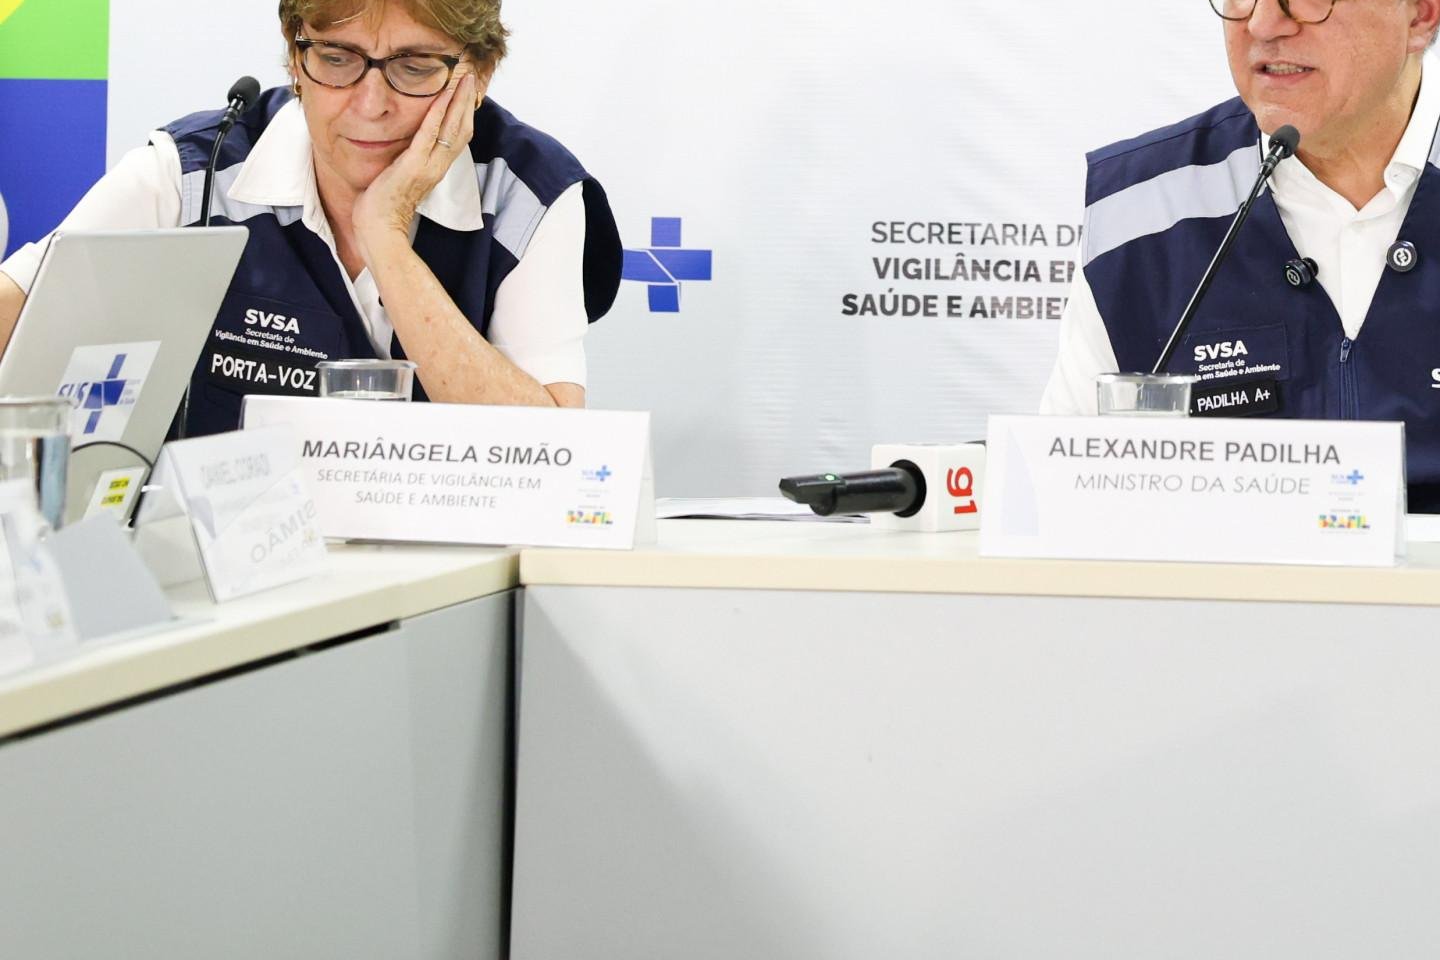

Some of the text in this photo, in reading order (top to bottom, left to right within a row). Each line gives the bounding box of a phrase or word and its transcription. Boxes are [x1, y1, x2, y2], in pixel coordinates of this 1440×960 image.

[871, 220, 1048, 247] SECRETARIA
[872, 252, 1042, 283] VIGILÂNCIA
[841, 287, 1069, 320] SAÚDE E AMBIE
[244, 308, 300, 334] SVSA
[245, 328, 295, 344] Secretaria de
[246, 337, 259, 347] em
[259, 339, 285, 351] Saúde
[290, 345, 329, 360] Ambiente
[1194, 340, 1249, 362] SVSA
[211, 353, 317, 391] PORTA-VOZ
[1198, 358, 1246, 372] Secretaria de
[1202, 372, 1215, 381] em
[1215, 368, 1238, 379] Saúde
[1244, 363, 1281, 375] Ambiente
[1197, 387, 1271, 412] PADILHA A+
[301, 436, 572, 467] MARIÂNGELA SIMÃO
[1048, 436, 1341, 465] ALEXANDRE PADILHA
[406, 471, 426, 485] DE
[430, 471, 514, 489] VIGILÂNCIA
[517, 476, 542, 489] EM
[1074, 472, 1184, 493] MINISTRO
[1190, 474, 1226, 493] DA
[1233, 473, 1310, 495] SAÚDE
[354, 488, 497, 509] SAÚDE E AMBIENTE
